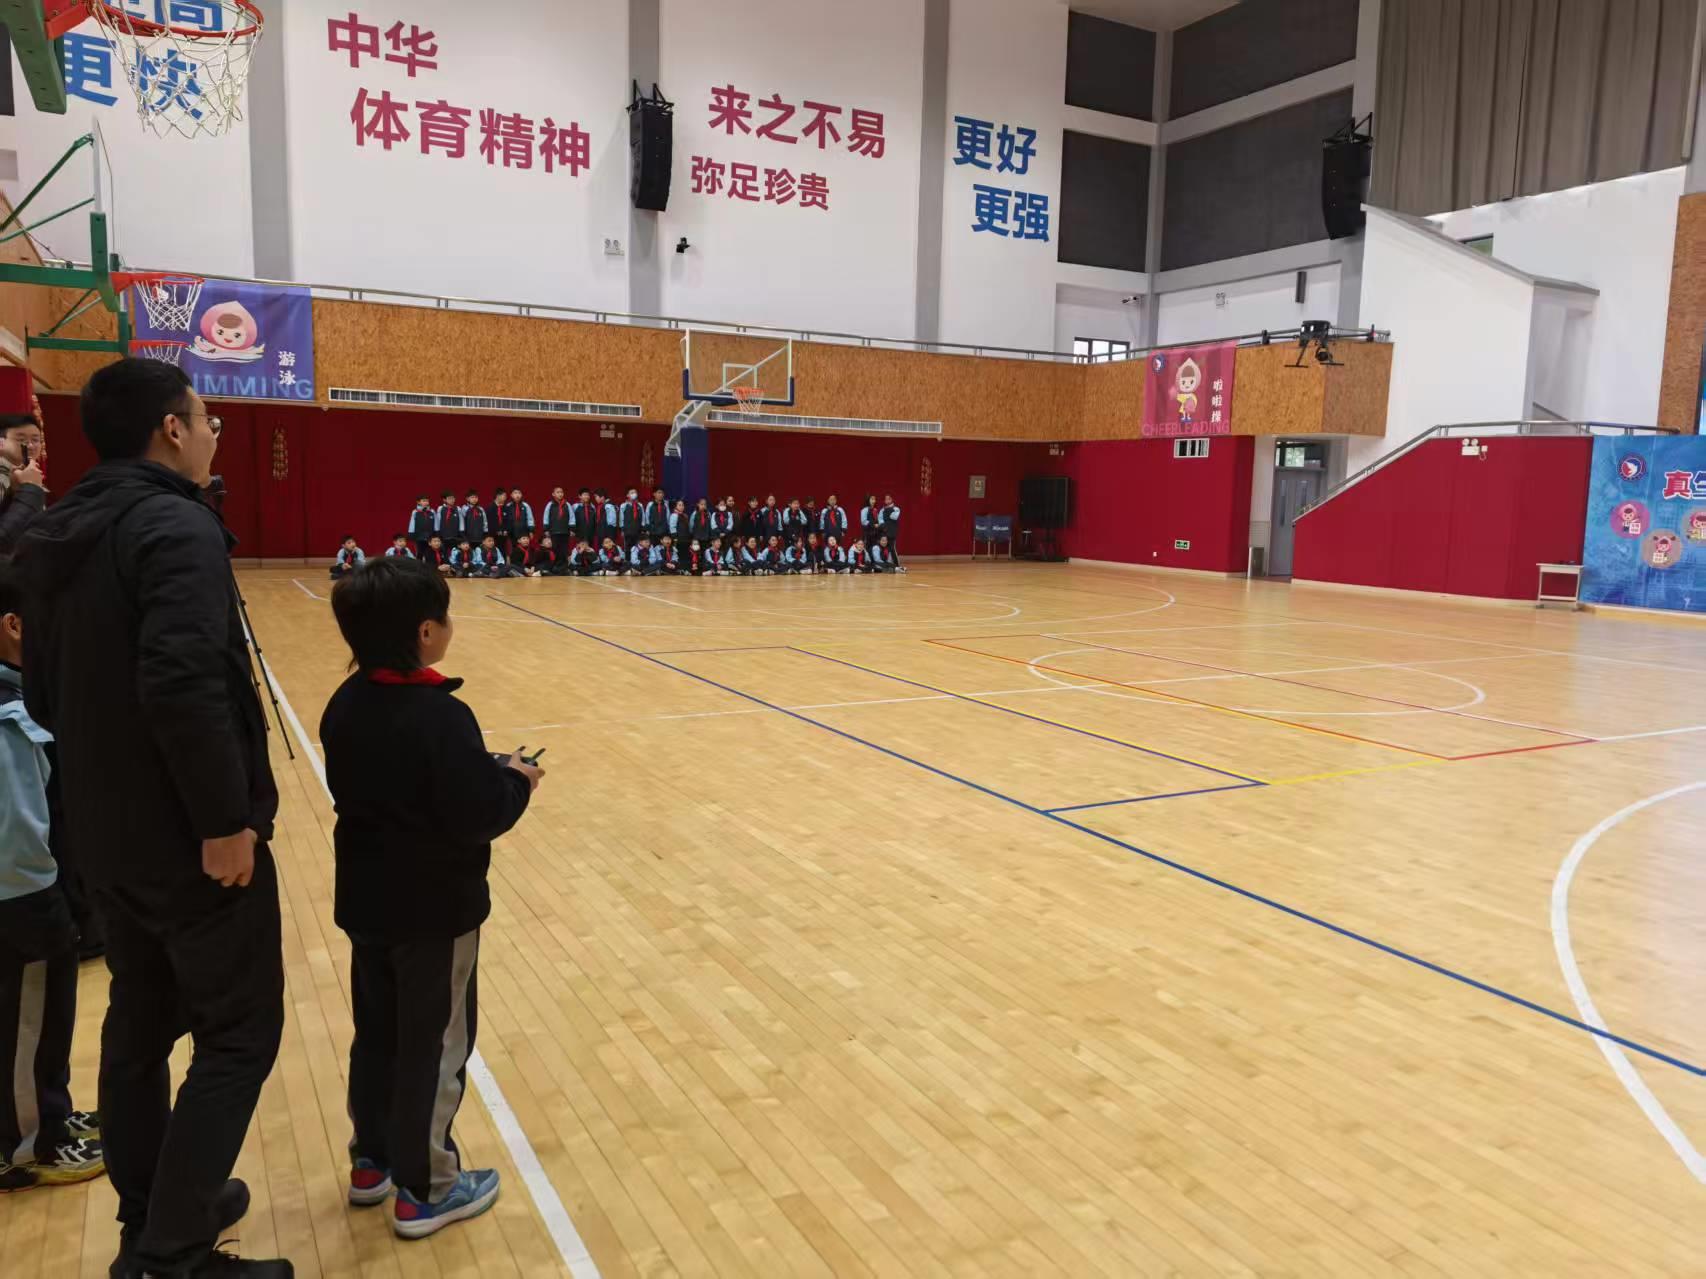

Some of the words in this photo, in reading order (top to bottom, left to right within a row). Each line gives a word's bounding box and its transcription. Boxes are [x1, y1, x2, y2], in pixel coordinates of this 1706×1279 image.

[327, 13, 438, 79] 中华
[63, 32, 204, 120] 更快
[350, 87, 592, 177] 体育精神
[708, 85, 886, 160] 来之不易
[952, 115, 1037, 175] 更好
[690, 156, 830, 210] 弥足珍贵
[971, 184, 1050, 242] 更强
[192, 373, 313, 399] IMMING
[278, 350, 297, 386] 游泳
[1142, 421, 1230, 437] CHEERLEADING
